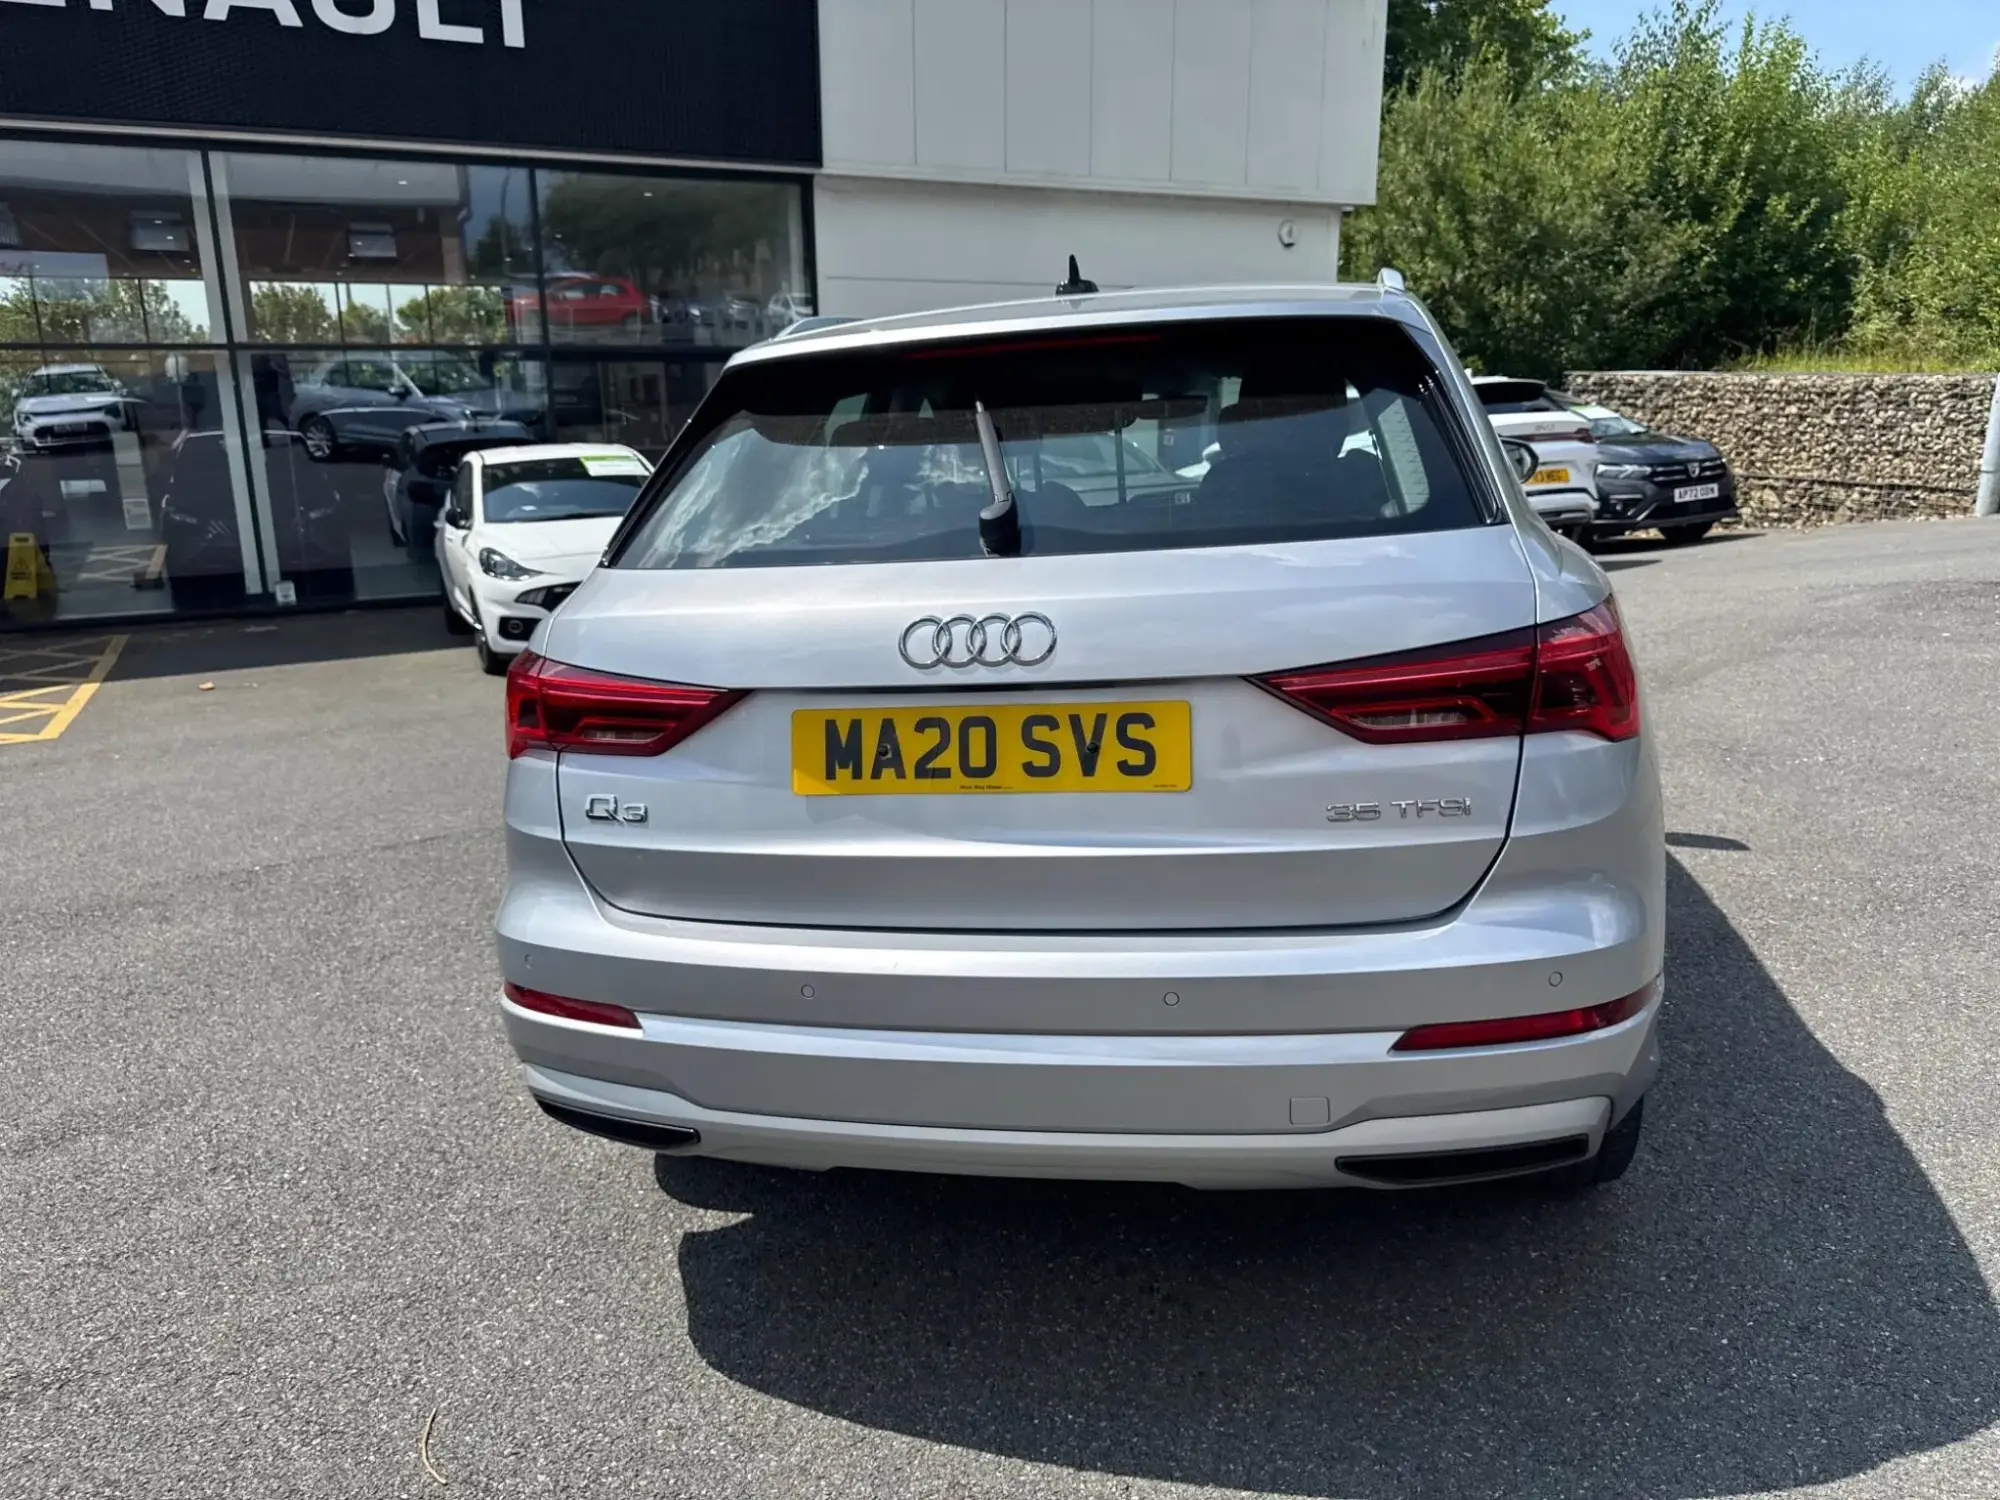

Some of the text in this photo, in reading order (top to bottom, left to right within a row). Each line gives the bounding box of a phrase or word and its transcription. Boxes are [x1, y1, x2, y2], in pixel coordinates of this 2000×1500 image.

[825, 712, 1157, 780] MA20 SVS
[585, 794, 648, 826] Q3
[1326, 802, 1381, 822] 35
